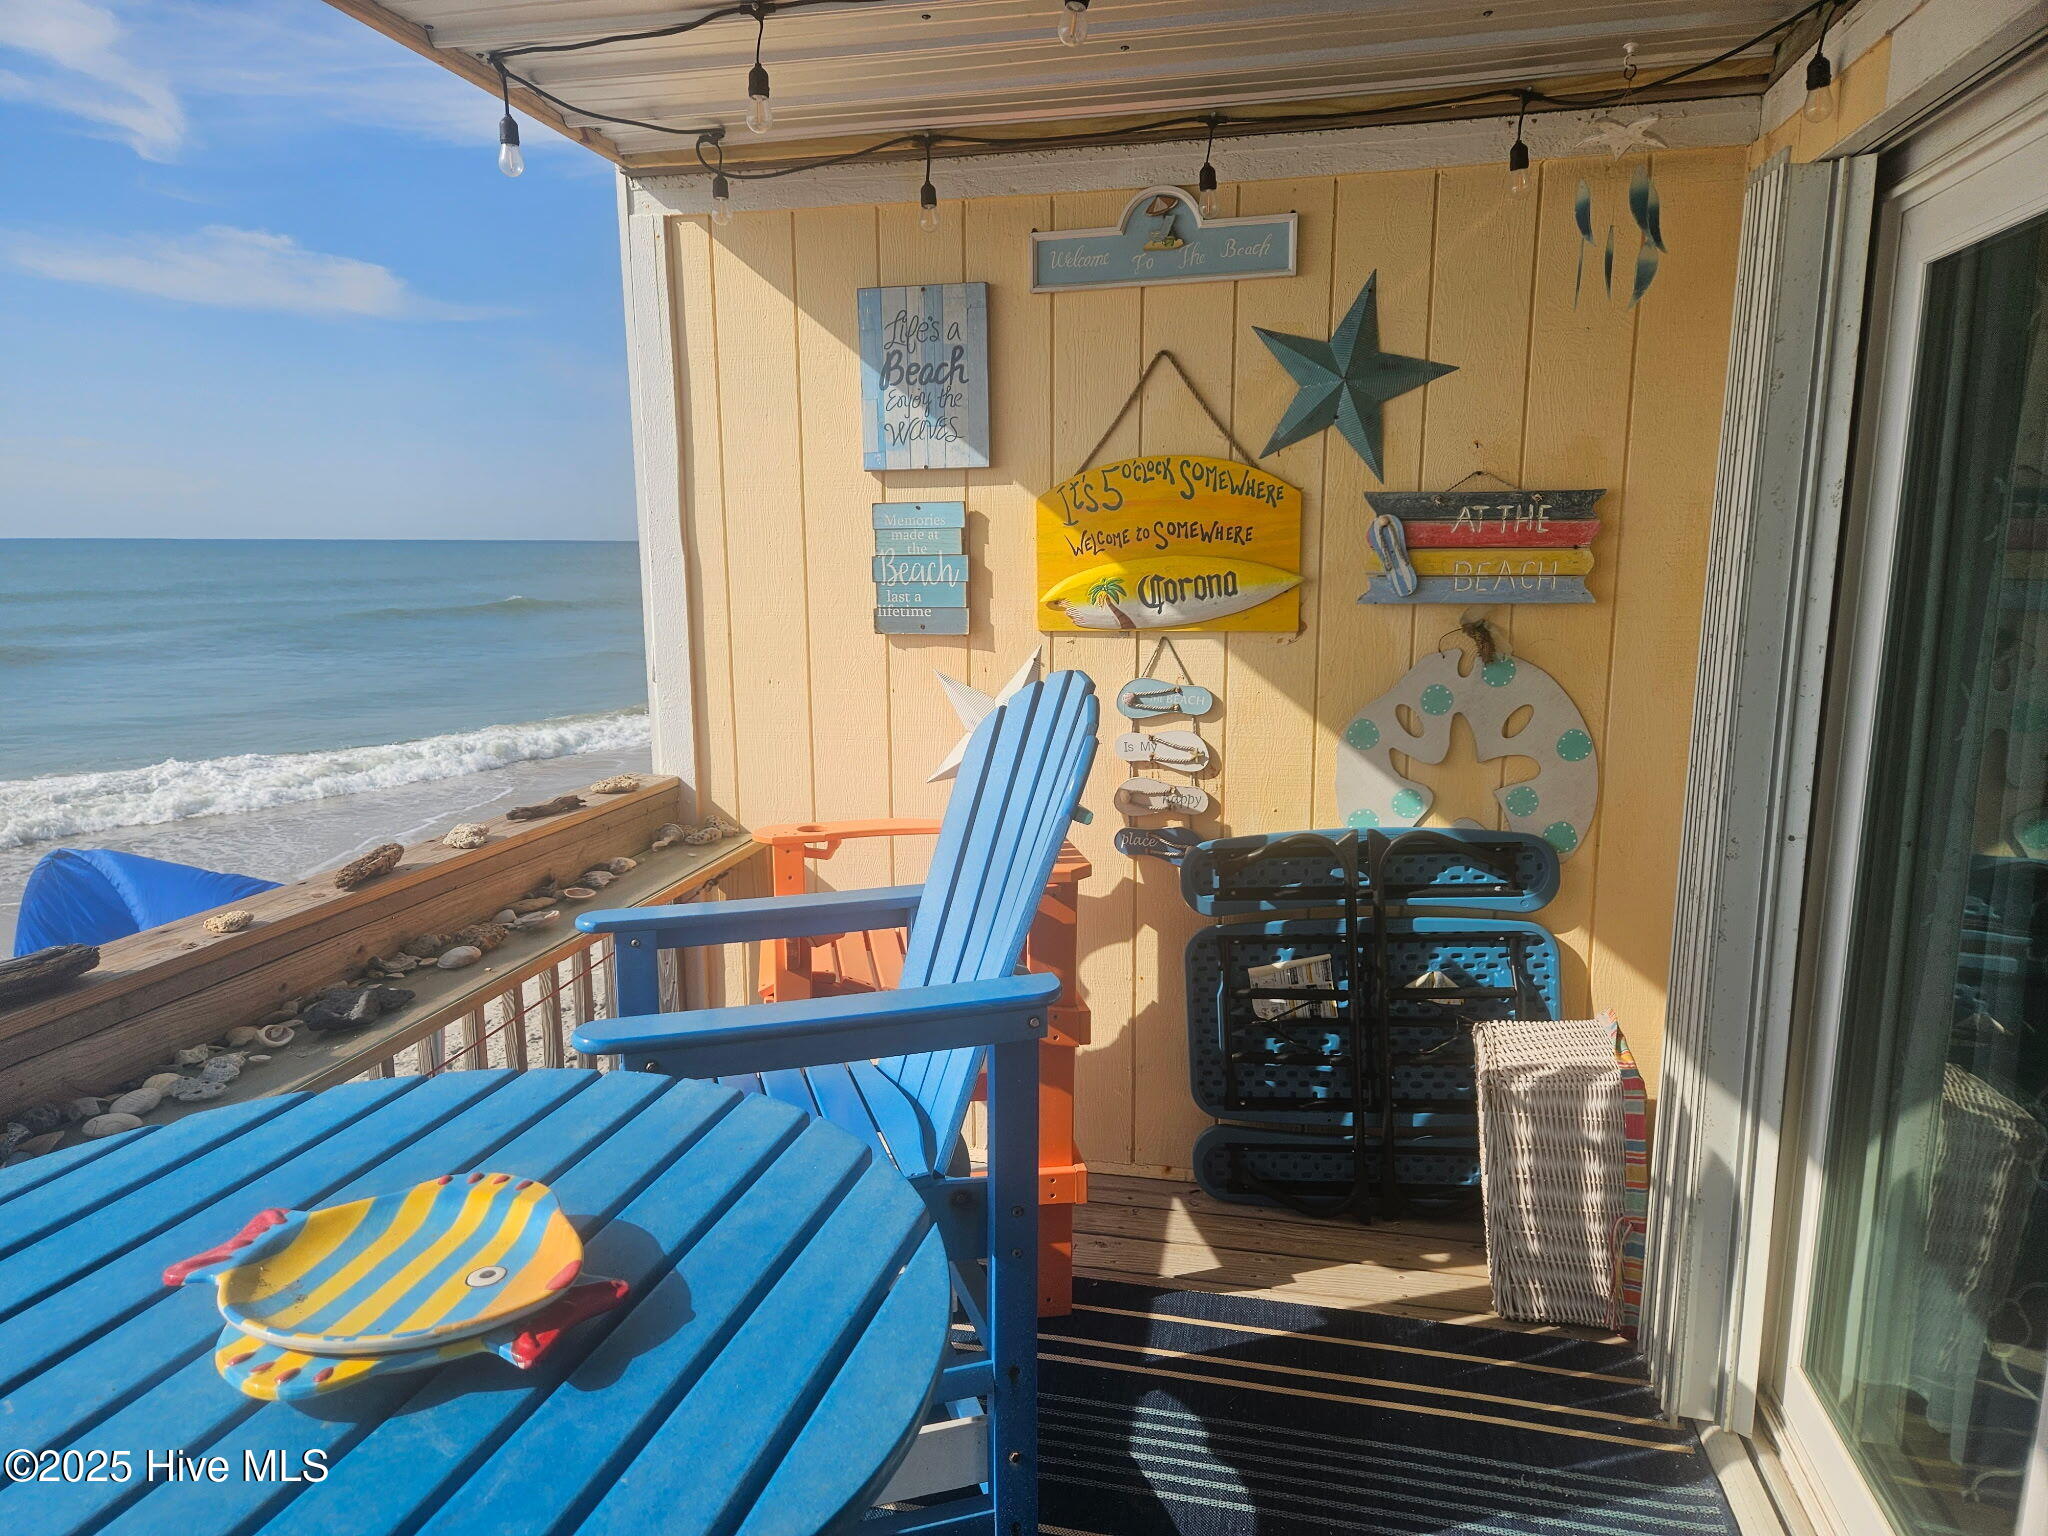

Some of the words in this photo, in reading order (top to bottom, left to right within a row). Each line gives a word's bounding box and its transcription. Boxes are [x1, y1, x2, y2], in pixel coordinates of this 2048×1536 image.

[1050, 245, 1110, 269] Welcome
[1131, 253, 1154, 274] To
[1178, 241, 1206, 269] The
[1220, 232, 1273, 258] Beach
[884, 309, 940, 354] Life's
[947, 321, 962, 342] a
[879, 345, 969, 391] Beach
[886, 388, 931, 419] Enjoy
[937, 385, 963, 408] the
[1101, 465, 1123, 511] 5
[884, 513, 946, 527] Memories
[1450, 505, 1490, 534] AT
[1496, 503, 1553, 534] THE
[891, 529, 924, 540] made
[928, 530, 939, 540] at
[907, 543, 927, 554] the
[880, 547, 960, 588] Beach
[1452, 559, 1558, 593] BEACH
[886, 589, 910, 602] last
[914, 593, 922, 602] a
[1137, 570, 1239, 615] Corona
[877, 604, 932, 617] lifetime
[1166, 695, 1205, 705] BEACH
[1123, 741, 1135, 753] Is
[1140, 741, 1158, 753] My
[1120, 832, 1159, 848] place
